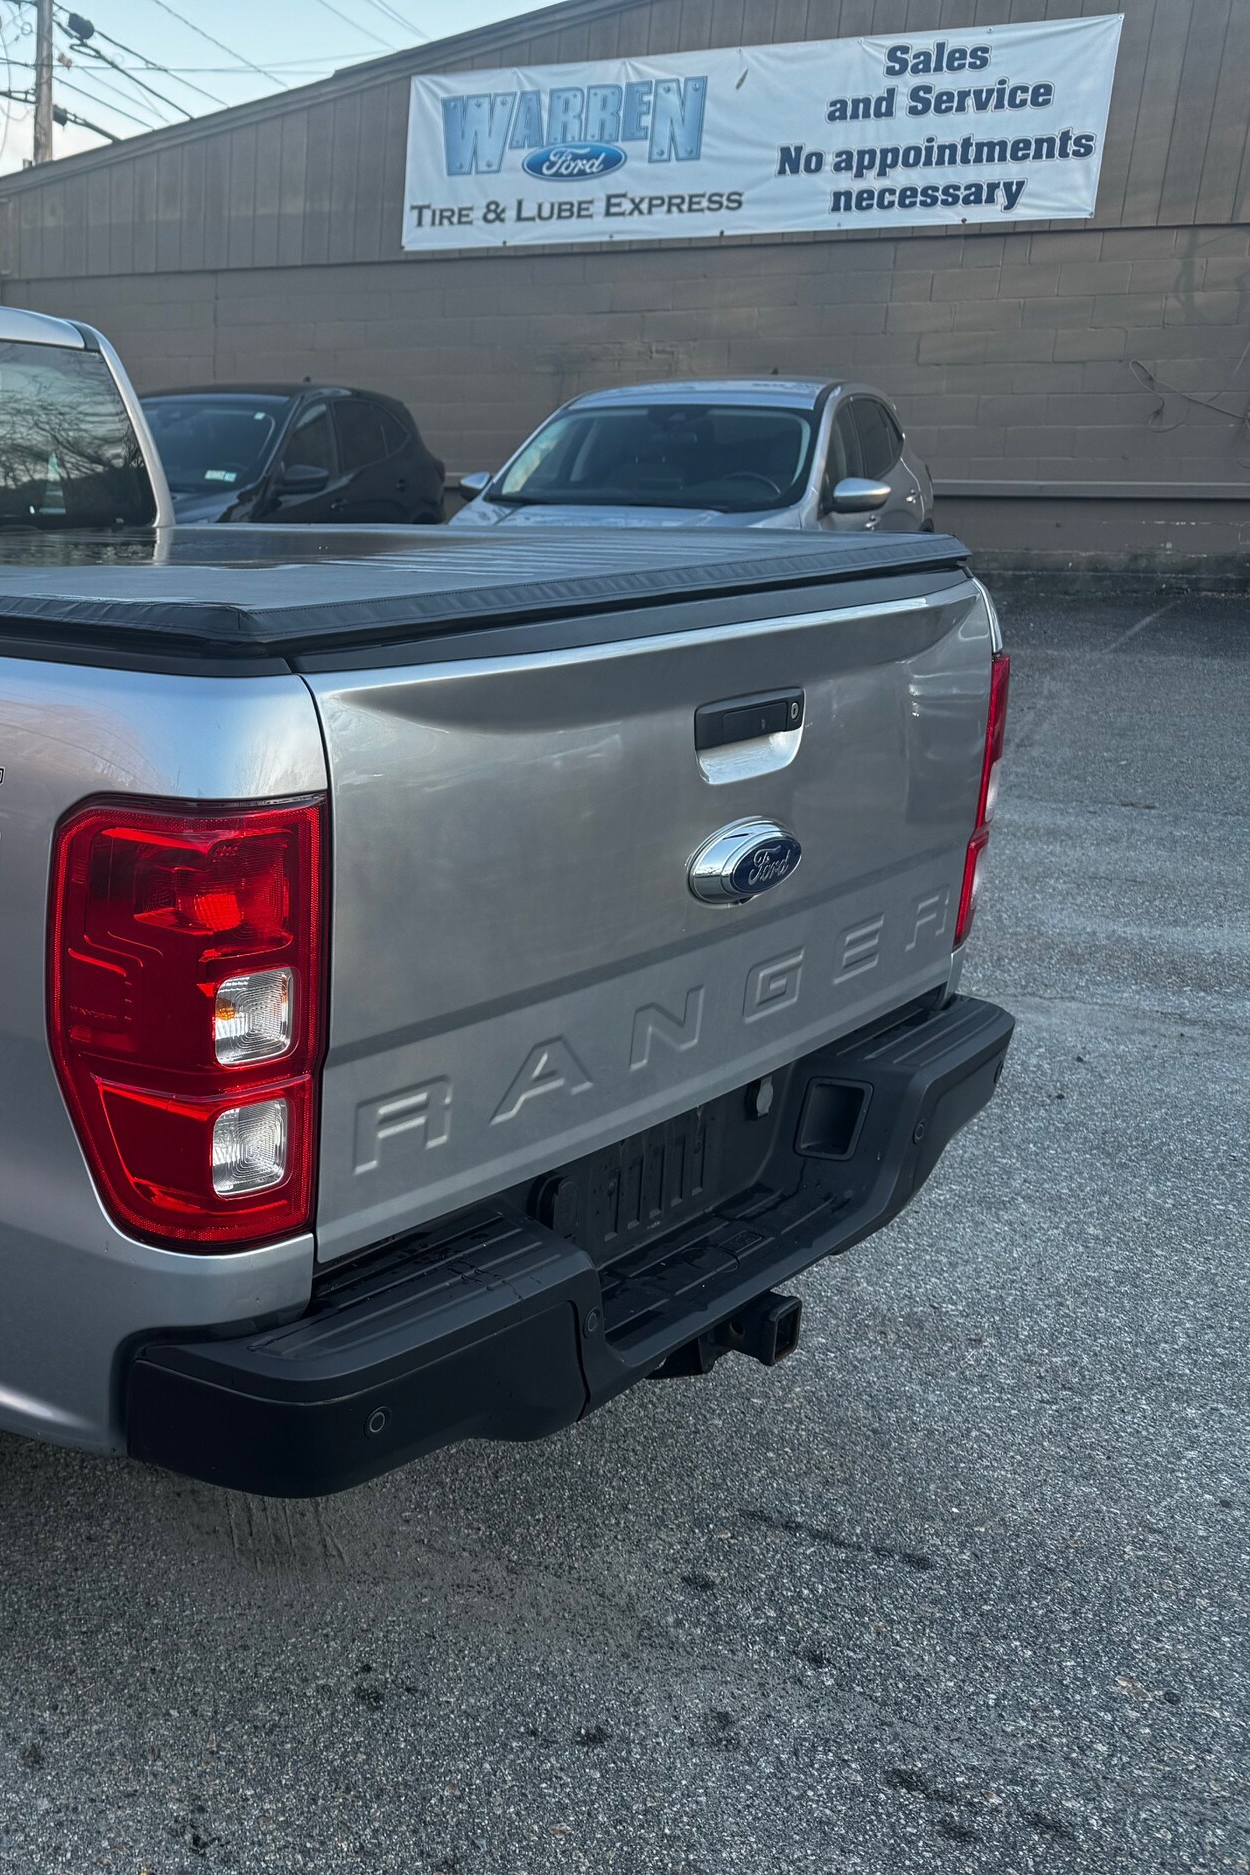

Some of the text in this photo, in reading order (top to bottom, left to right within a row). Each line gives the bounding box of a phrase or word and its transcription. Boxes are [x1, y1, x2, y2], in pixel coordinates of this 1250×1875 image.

[885, 42, 991, 77] Sales
[826, 78, 1053, 123] and Service
[441, 77, 708, 176] WARREN
[542, 147, 606, 175] Ford
[777, 128, 1096, 178] No appointments
[410, 190, 744, 228] TIRE & LUBE EXPRESS
[831, 178, 1026, 212] necessary
[748, 845, 791, 886] Ford
[353, 888, 949, 1177] RANGER
